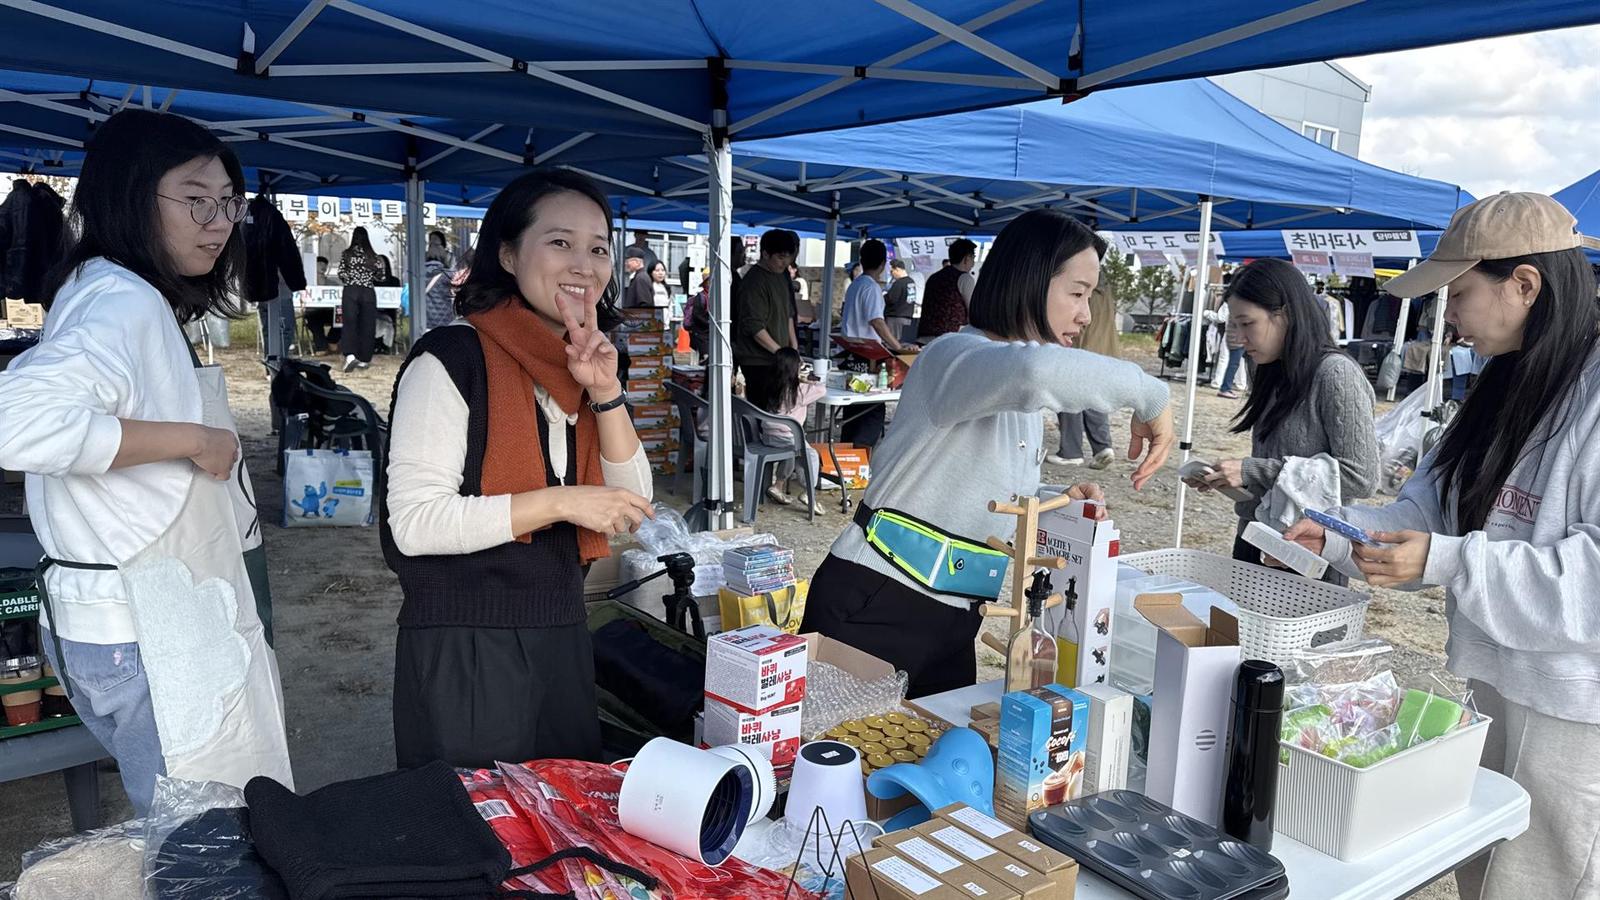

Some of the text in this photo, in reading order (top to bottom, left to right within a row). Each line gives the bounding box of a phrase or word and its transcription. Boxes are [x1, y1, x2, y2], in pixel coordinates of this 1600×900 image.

[321, 201, 400, 218] 이벤트
[1071, 553, 1083, 565] SET
[0, 595, 38, 607] DABLE
[5, 603, 40, 614] CARRI
[760, 662, 778, 677] 바퀴
[760, 669, 793, 690] 벌레사냥
[741, 721, 763, 735] 바퀴
